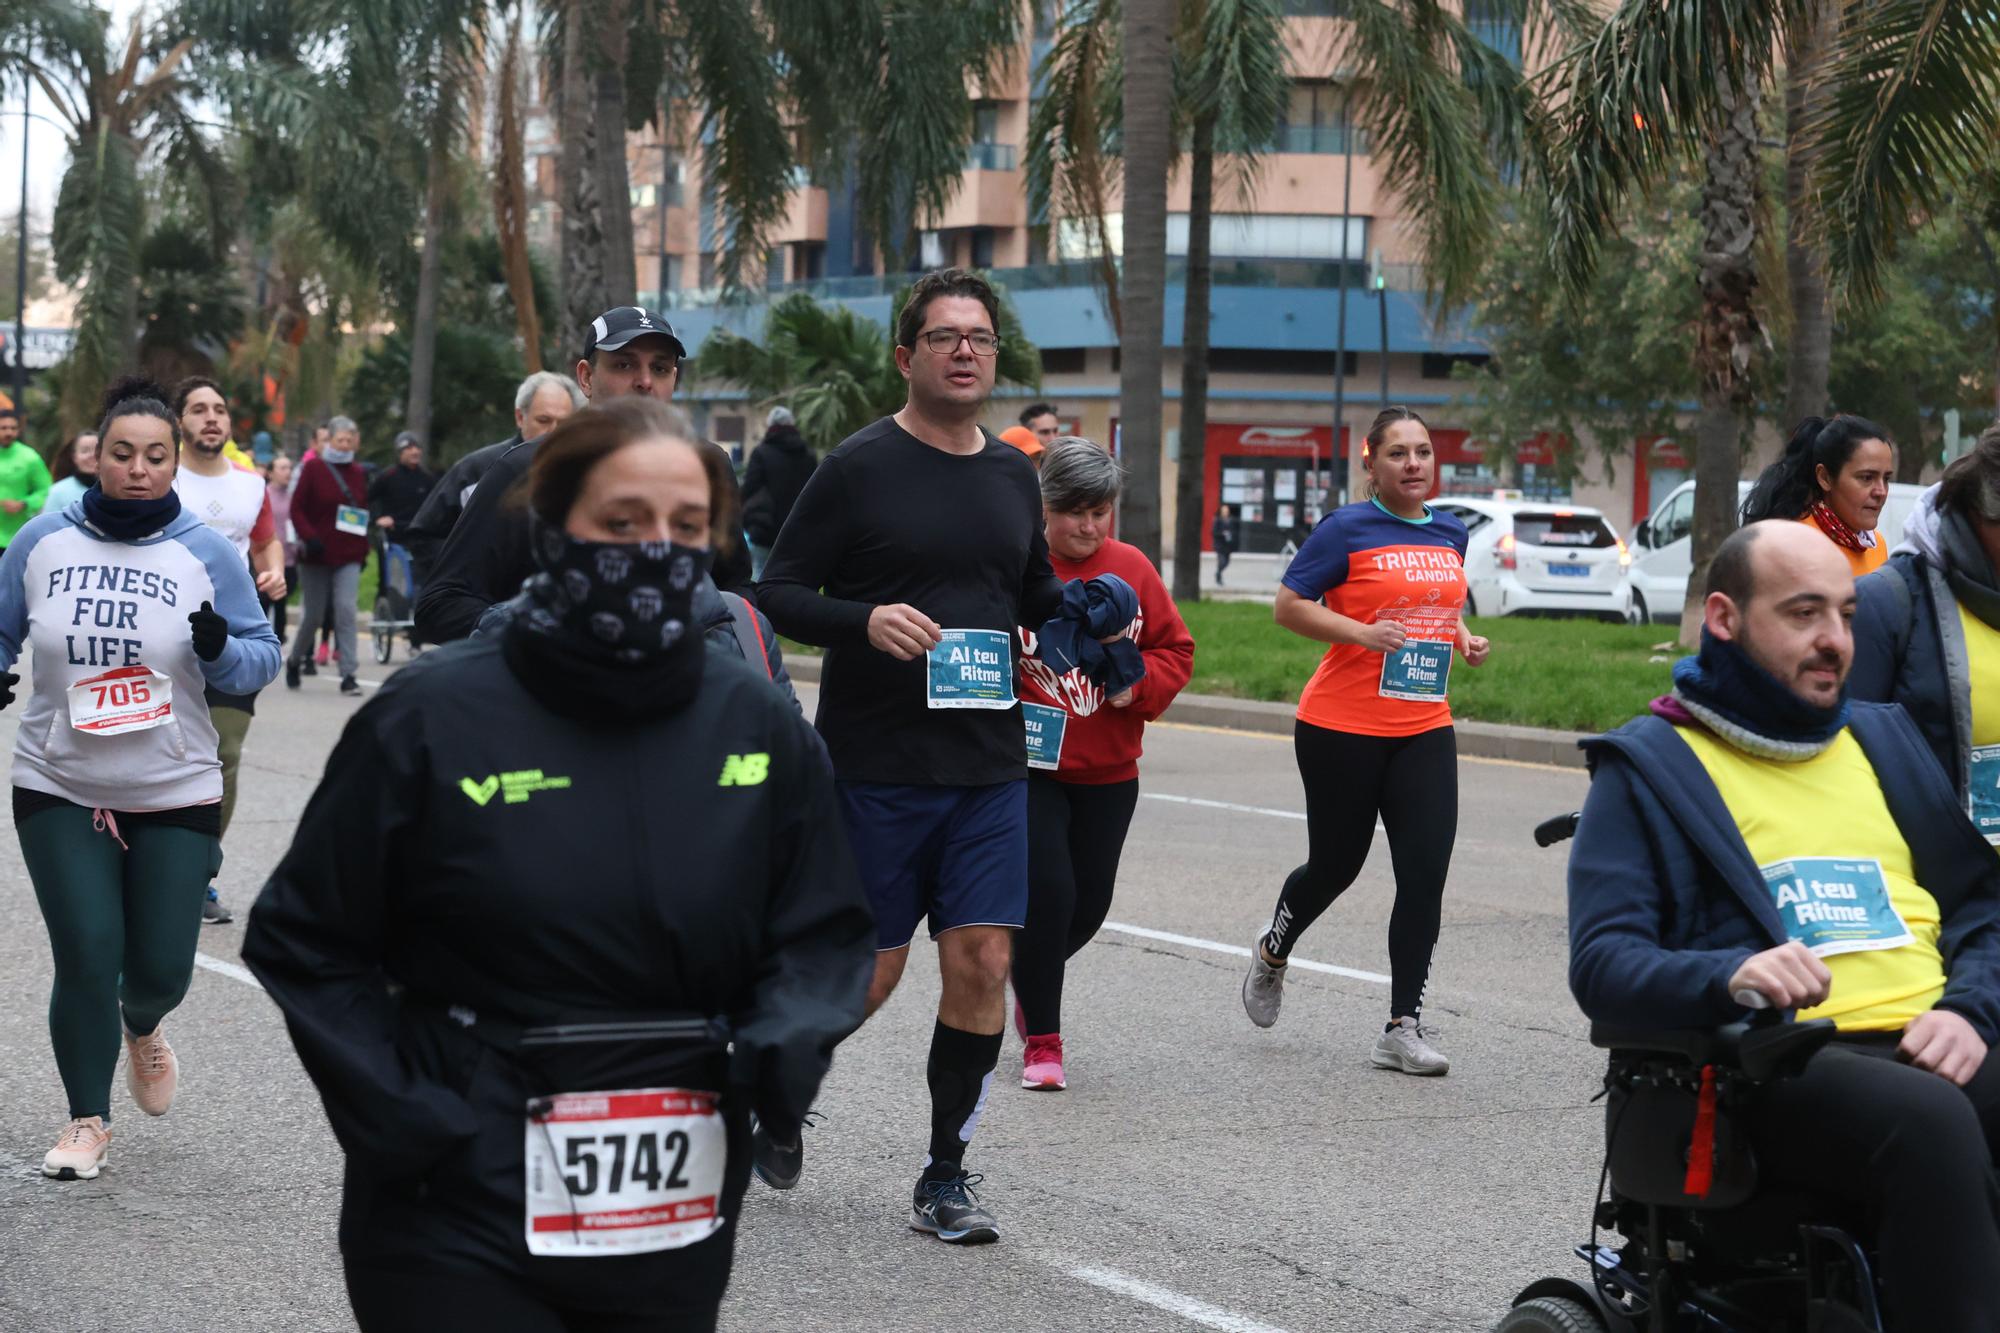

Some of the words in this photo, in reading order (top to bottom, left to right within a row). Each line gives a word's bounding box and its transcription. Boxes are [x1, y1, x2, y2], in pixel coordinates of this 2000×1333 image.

[47, 566, 178, 607] FITNESS
[1405, 570, 1458, 582] GANDIA
[72, 598, 138, 630] FOR
[66, 635, 142, 667] LIFE
[949, 646, 970, 664] Al
[973, 648, 998, 665] teu
[1401, 652, 1418, 666] Al
[1420, 655, 1438, 667] teu
[960, 665, 1001, 682] Ritme
[1407, 667, 1437, 681] Ritme
[90, 680, 151, 709] 705
[1025, 719, 1043, 733] eu
[718, 752, 770, 786] NB
[1776, 878, 1809, 909] Al
[1810, 880, 1857, 899] teu
[1269, 900, 1294, 955] NIKE
[1794, 901, 1869, 925] Ritme
[564, 1129, 690, 1196] 5742
